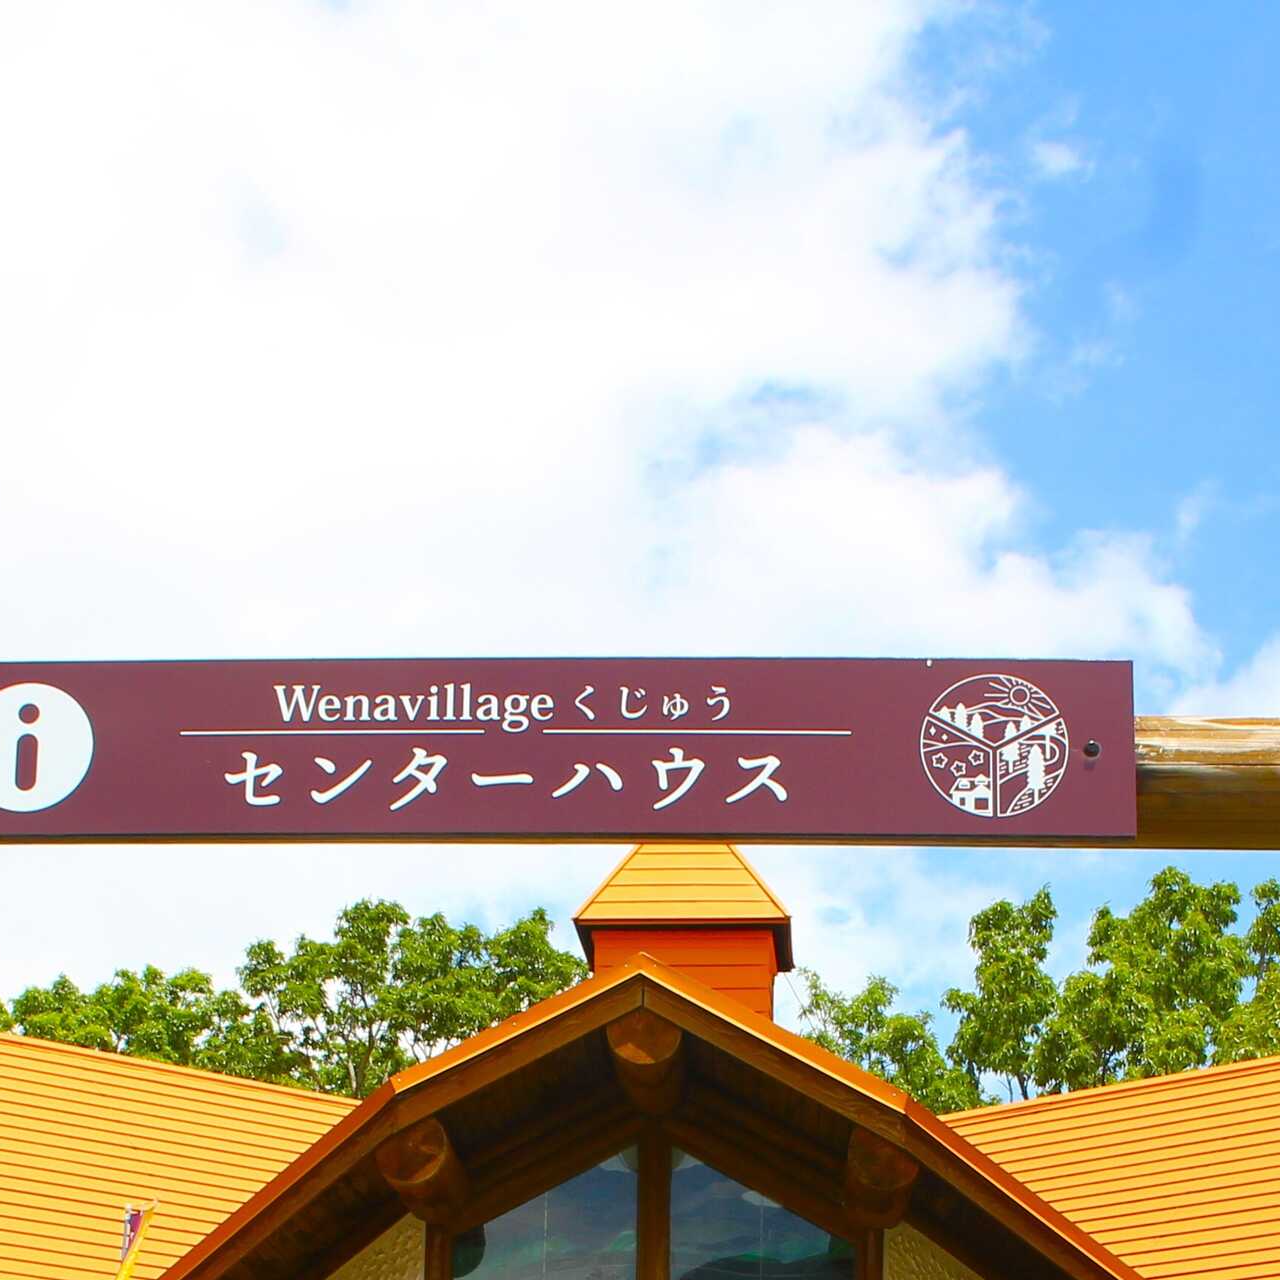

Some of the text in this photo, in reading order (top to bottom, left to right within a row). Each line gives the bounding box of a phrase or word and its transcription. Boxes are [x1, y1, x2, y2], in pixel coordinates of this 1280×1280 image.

[273, 682, 730, 733] Wenavillage くじゅう
[223, 747, 788, 811] センターハウス
